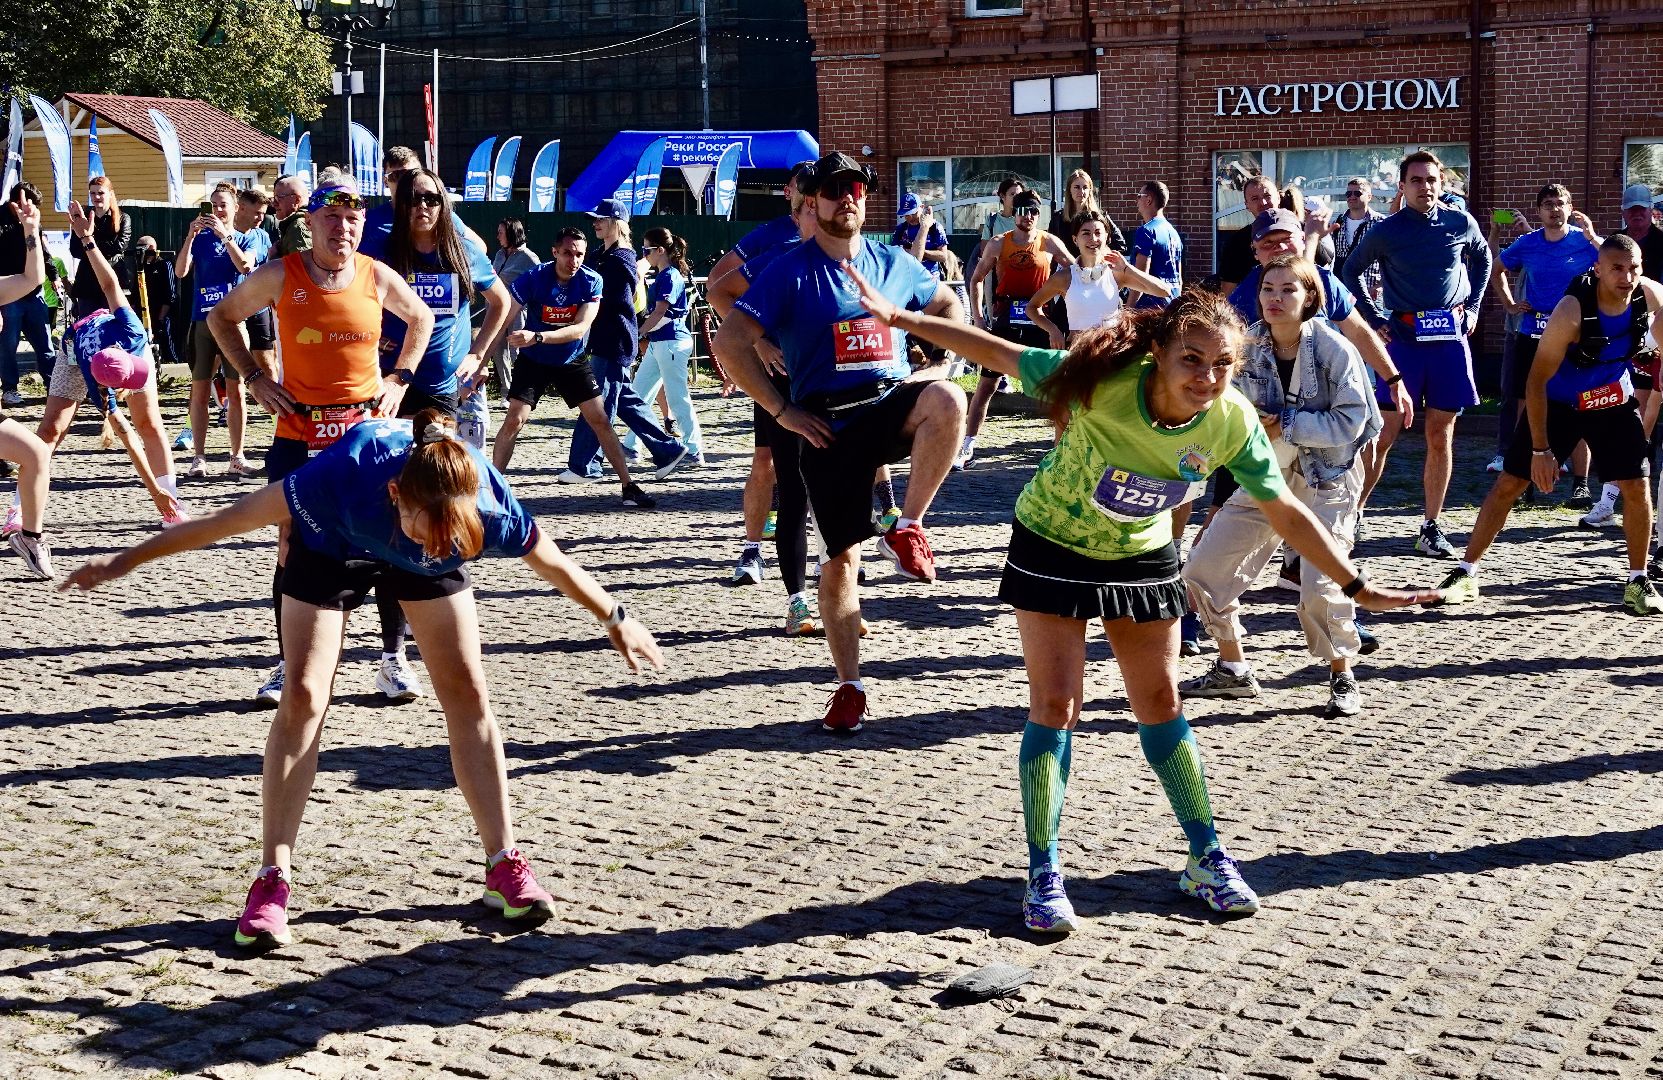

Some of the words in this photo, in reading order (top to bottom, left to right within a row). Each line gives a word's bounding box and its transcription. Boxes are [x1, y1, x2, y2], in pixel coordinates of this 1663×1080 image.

[1214, 77, 1460, 116] ГАСТРОНОМ
[664, 142, 694, 152] Реки
[697, 142, 742, 152] Росс
[672, 153, 721, 163] #рекибе
[204, 292, 224, 301] 1291
[1014, 307, 1026, 315] 13
[1420, 318, 1450, 328] 1202
[846, 333, 884, 350] 2141
[1585, 393, 1618, 409] 2106
[1114, 485, 1168, 509] 1251
